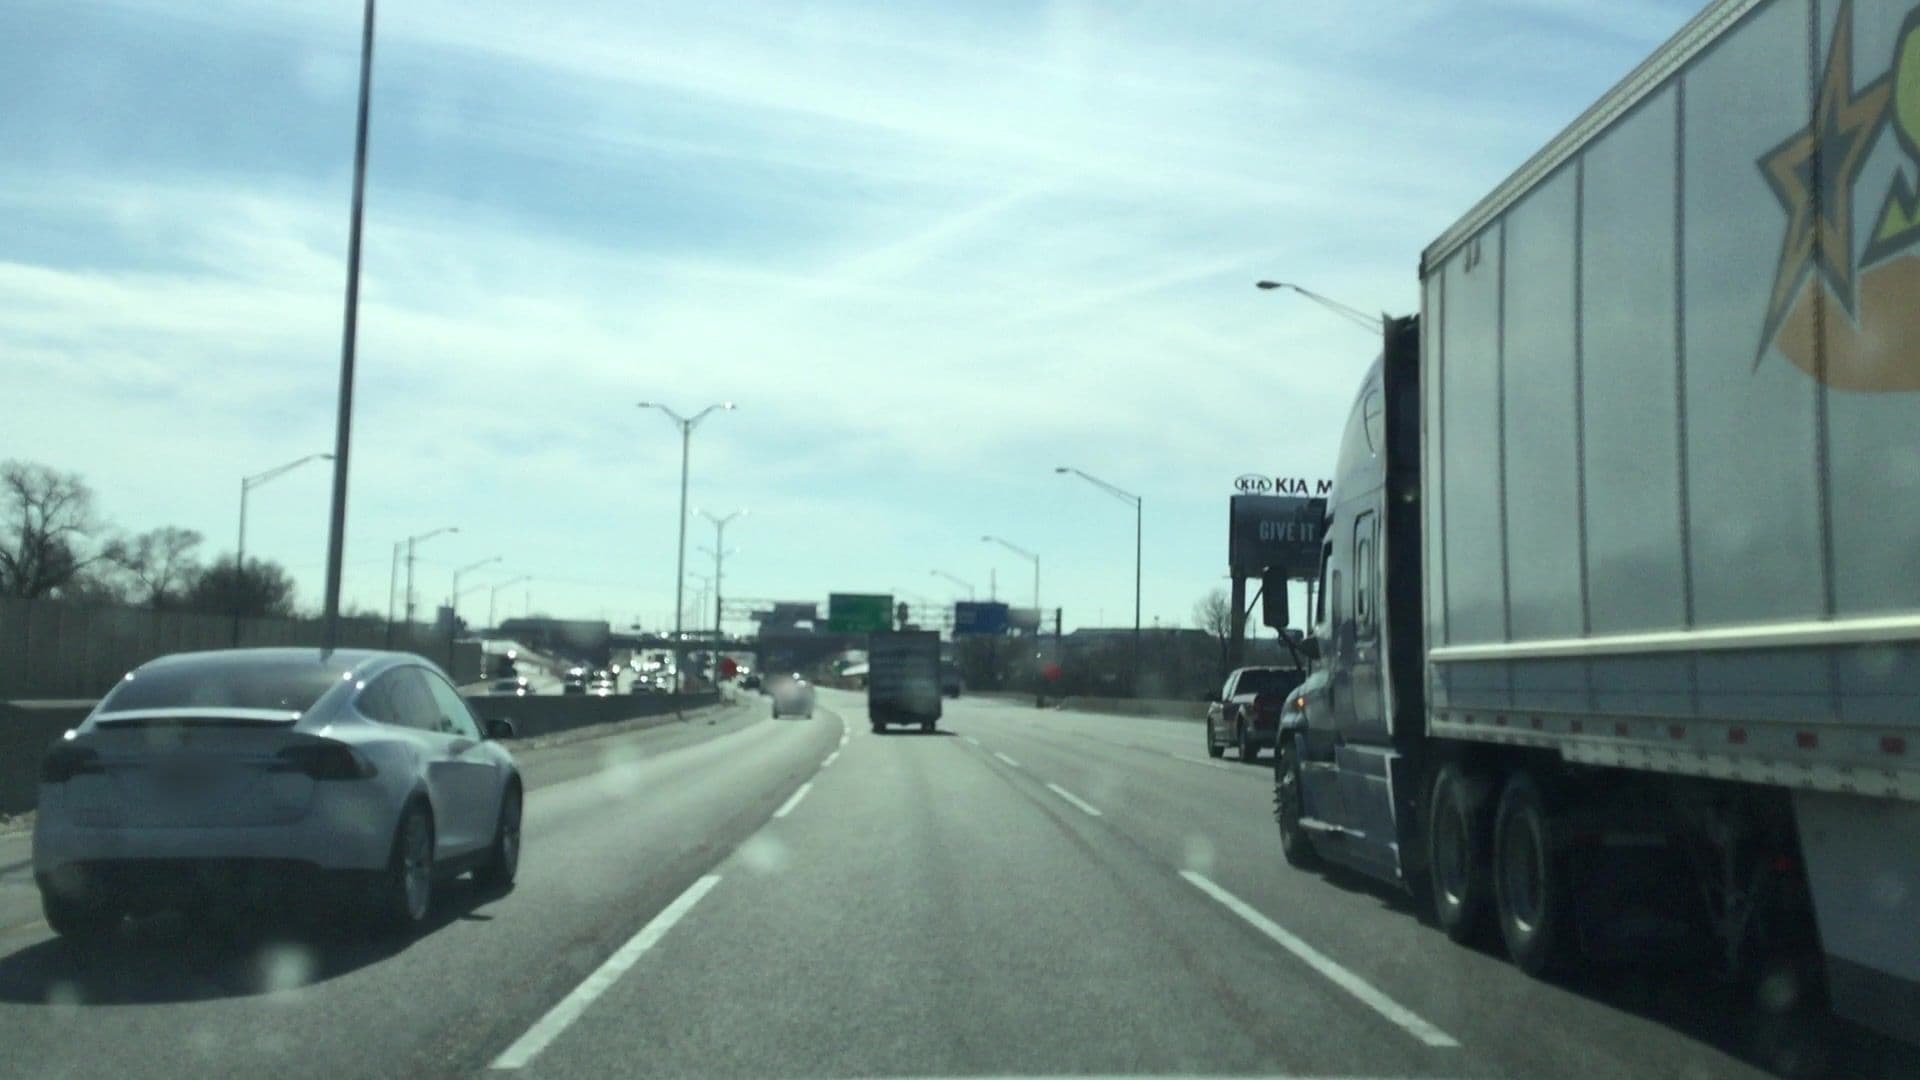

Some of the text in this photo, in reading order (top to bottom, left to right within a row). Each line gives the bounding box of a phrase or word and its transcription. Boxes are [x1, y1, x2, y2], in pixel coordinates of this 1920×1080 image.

[1276, 478, 1309, 493] KIA
[1260, 521, 1314, 541] GIVE IT
